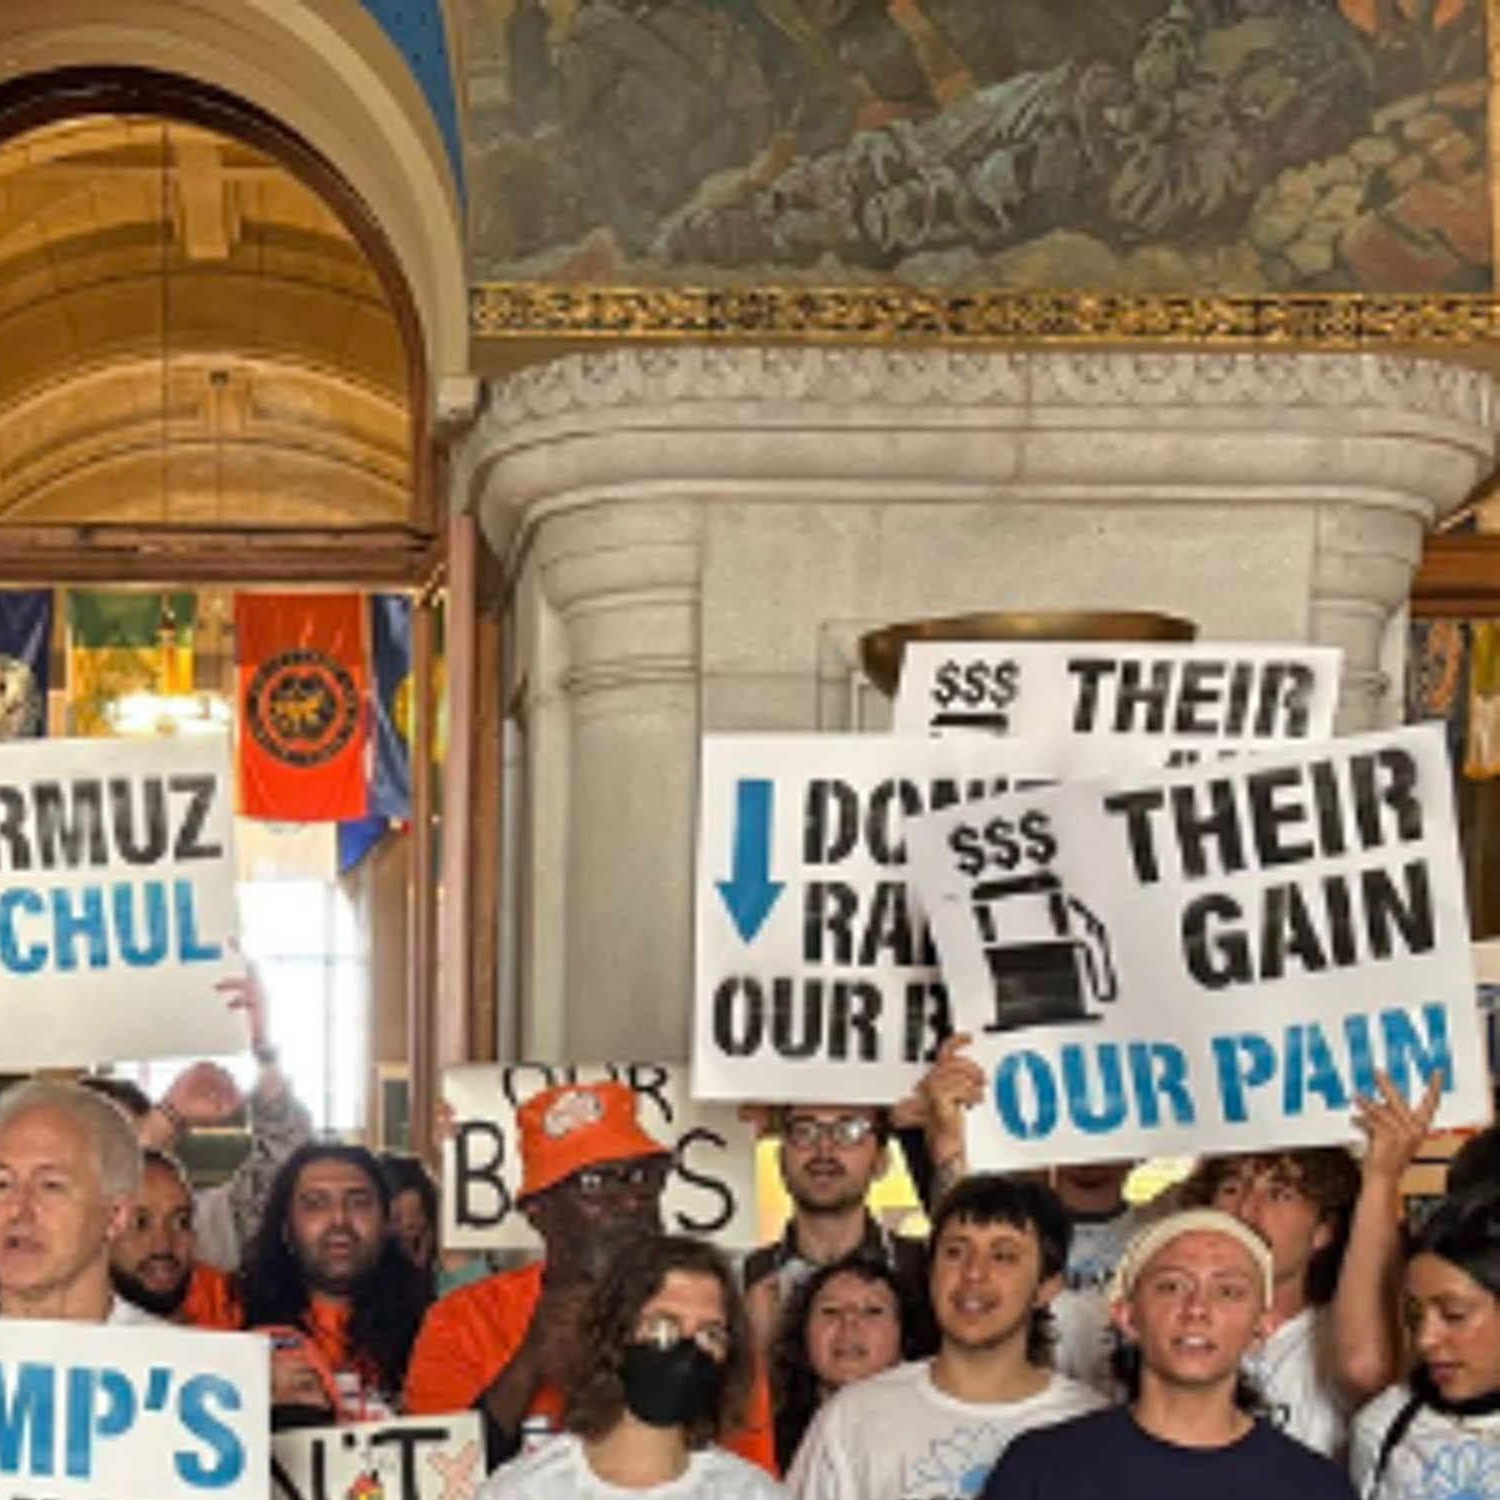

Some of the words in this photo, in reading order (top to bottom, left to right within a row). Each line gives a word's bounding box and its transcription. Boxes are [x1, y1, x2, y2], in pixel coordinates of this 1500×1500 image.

[1067, 658, 1315, 738] THEIR
[949, 809, 1057, 877] $$$
[1103, 748, 1424, 885] THEIR
[1181, 860, 1437, 990] GAIN
[712, 976, 882, 1061] OUR
[994, 1042, 1197, 1141] OUR
[1211, 1002, 1455, 1123] PAIN
